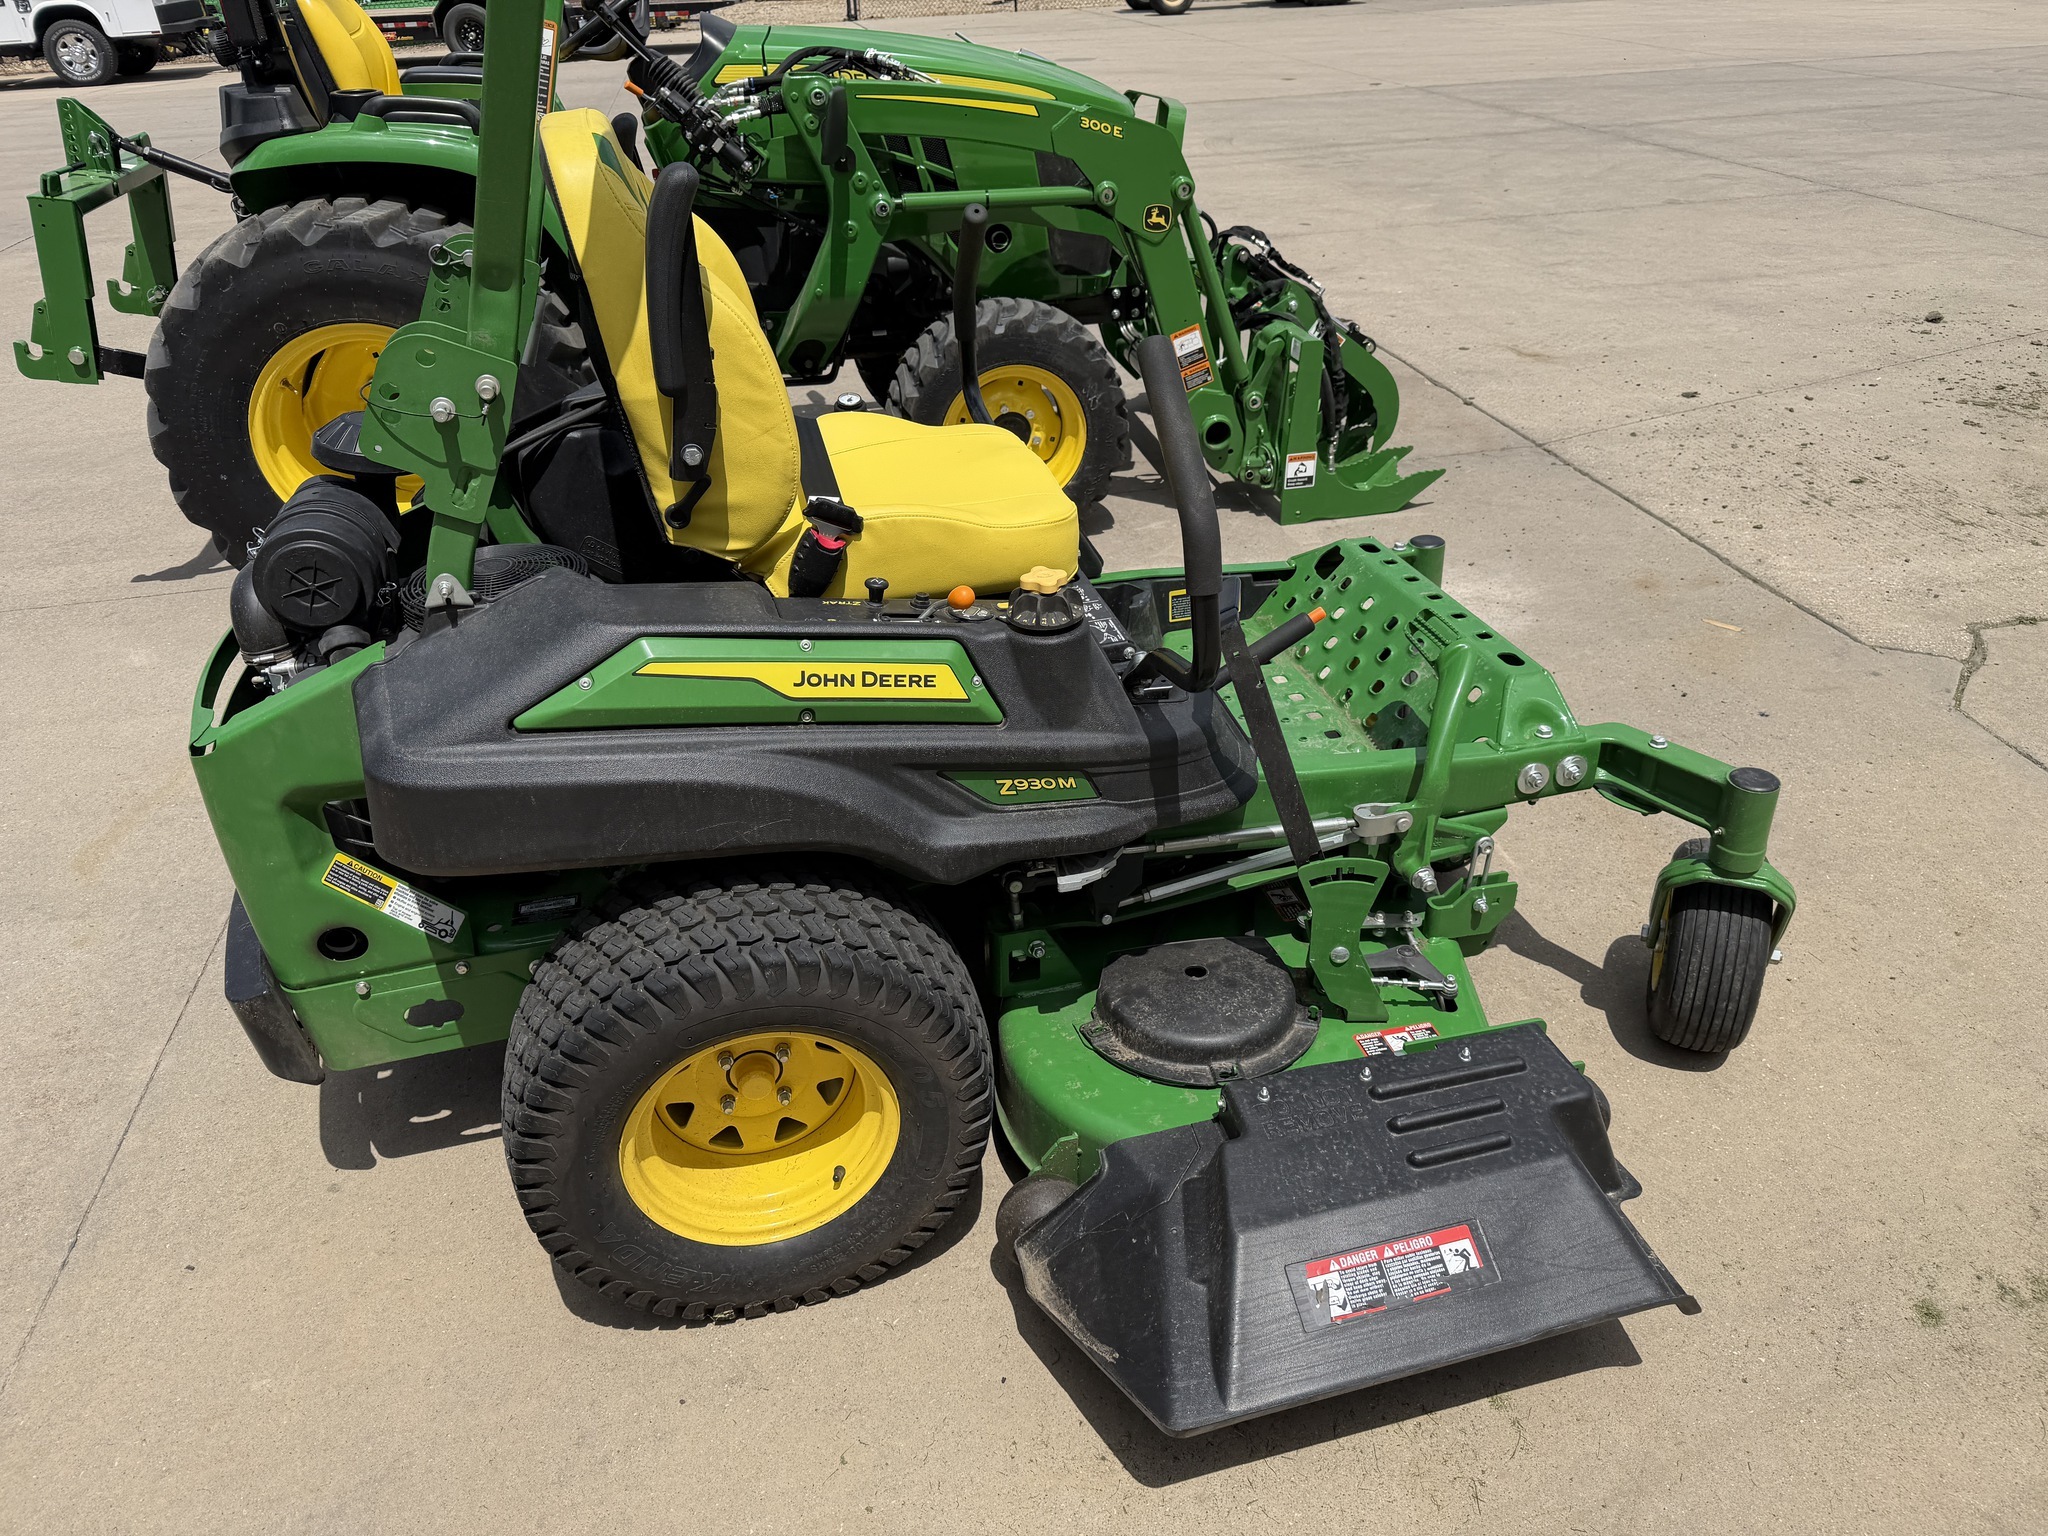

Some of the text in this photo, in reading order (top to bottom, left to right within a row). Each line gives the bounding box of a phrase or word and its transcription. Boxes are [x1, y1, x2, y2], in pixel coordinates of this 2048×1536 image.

[303, 258, 428, 286] GALAX
[793, 670, 937, 688] JOHN DEERE
[995, 776, 1077, 797] Z930M
[353, 864, 384, 882] CAUTION
[1392, 1235, 1434, 1254] PELIGRO
[593, 1222, 731, 1294] KENDA
[1338, 1249, 1379, 1267] DANGER
